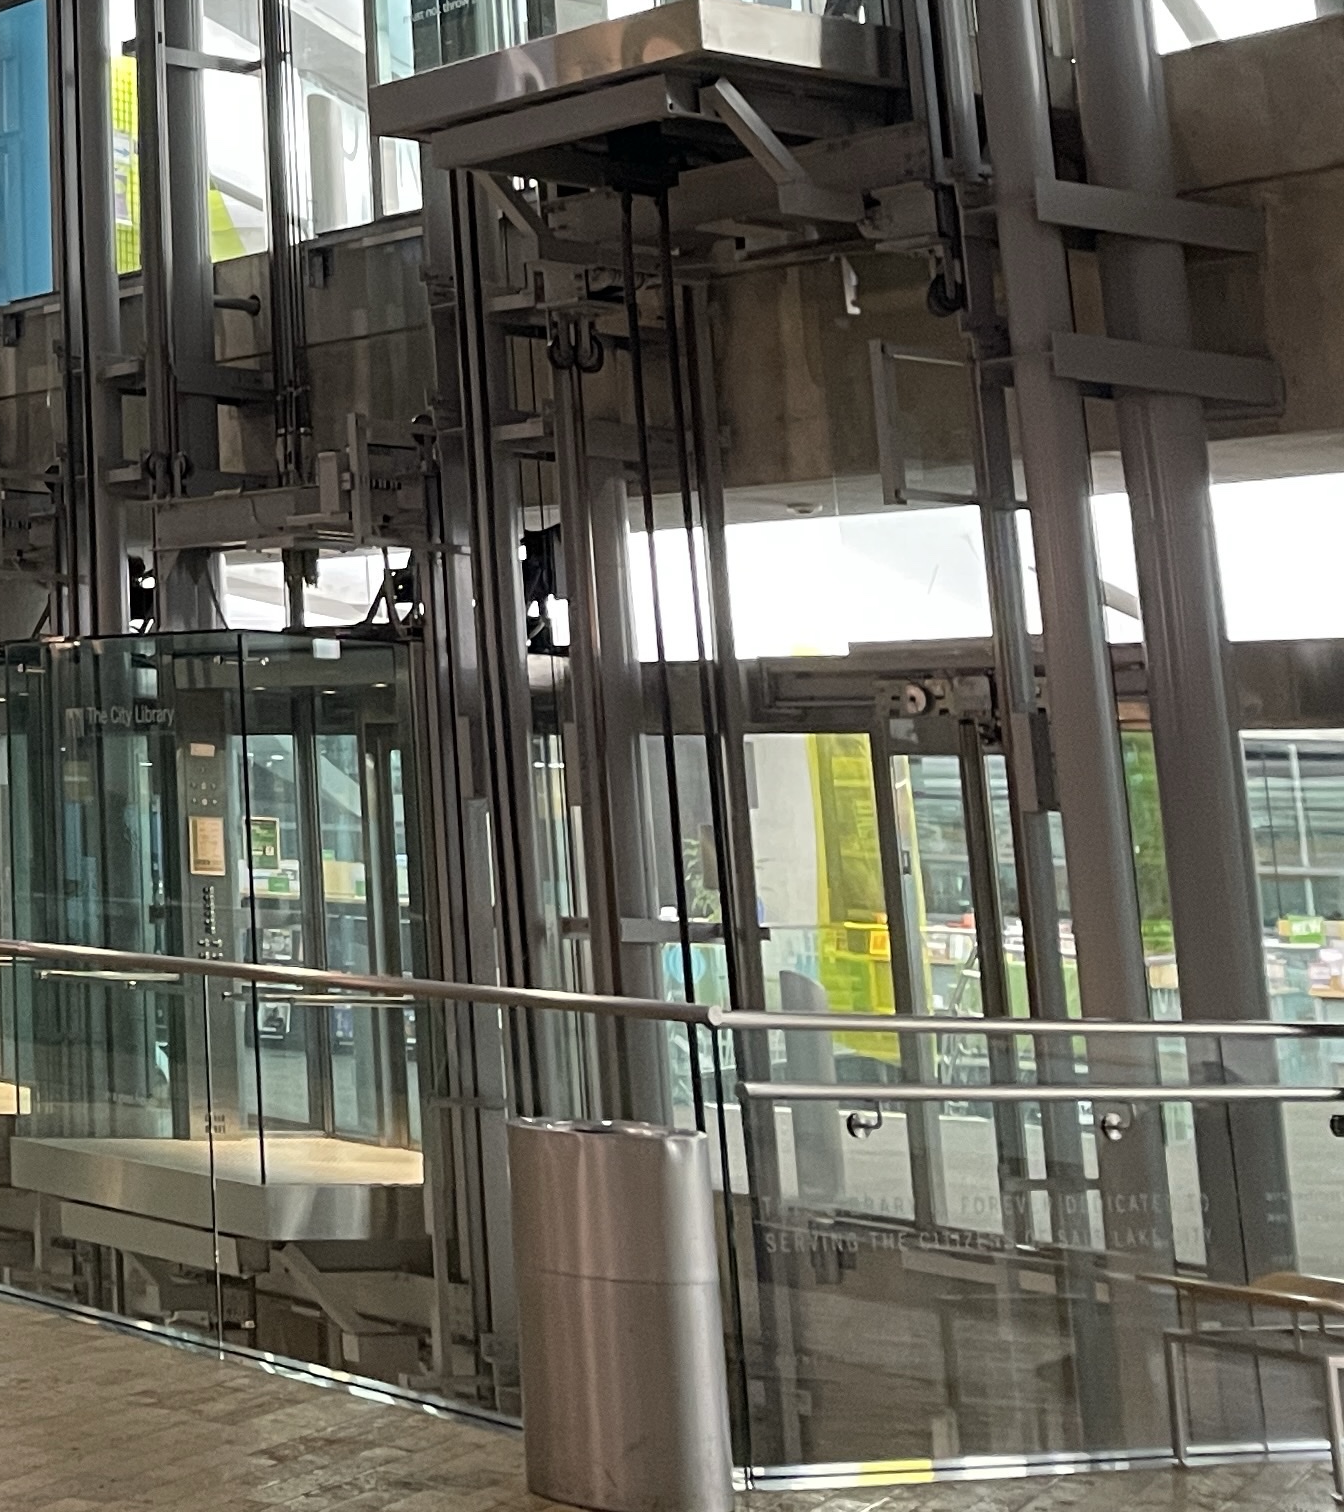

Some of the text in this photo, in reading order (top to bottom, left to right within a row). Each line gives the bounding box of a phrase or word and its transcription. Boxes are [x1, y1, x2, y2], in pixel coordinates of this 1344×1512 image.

[86, 705, 174, 727] The City Library
[765, 1231, 860, 1254] SERVING
[870, 1231, 910, 1253] THE
